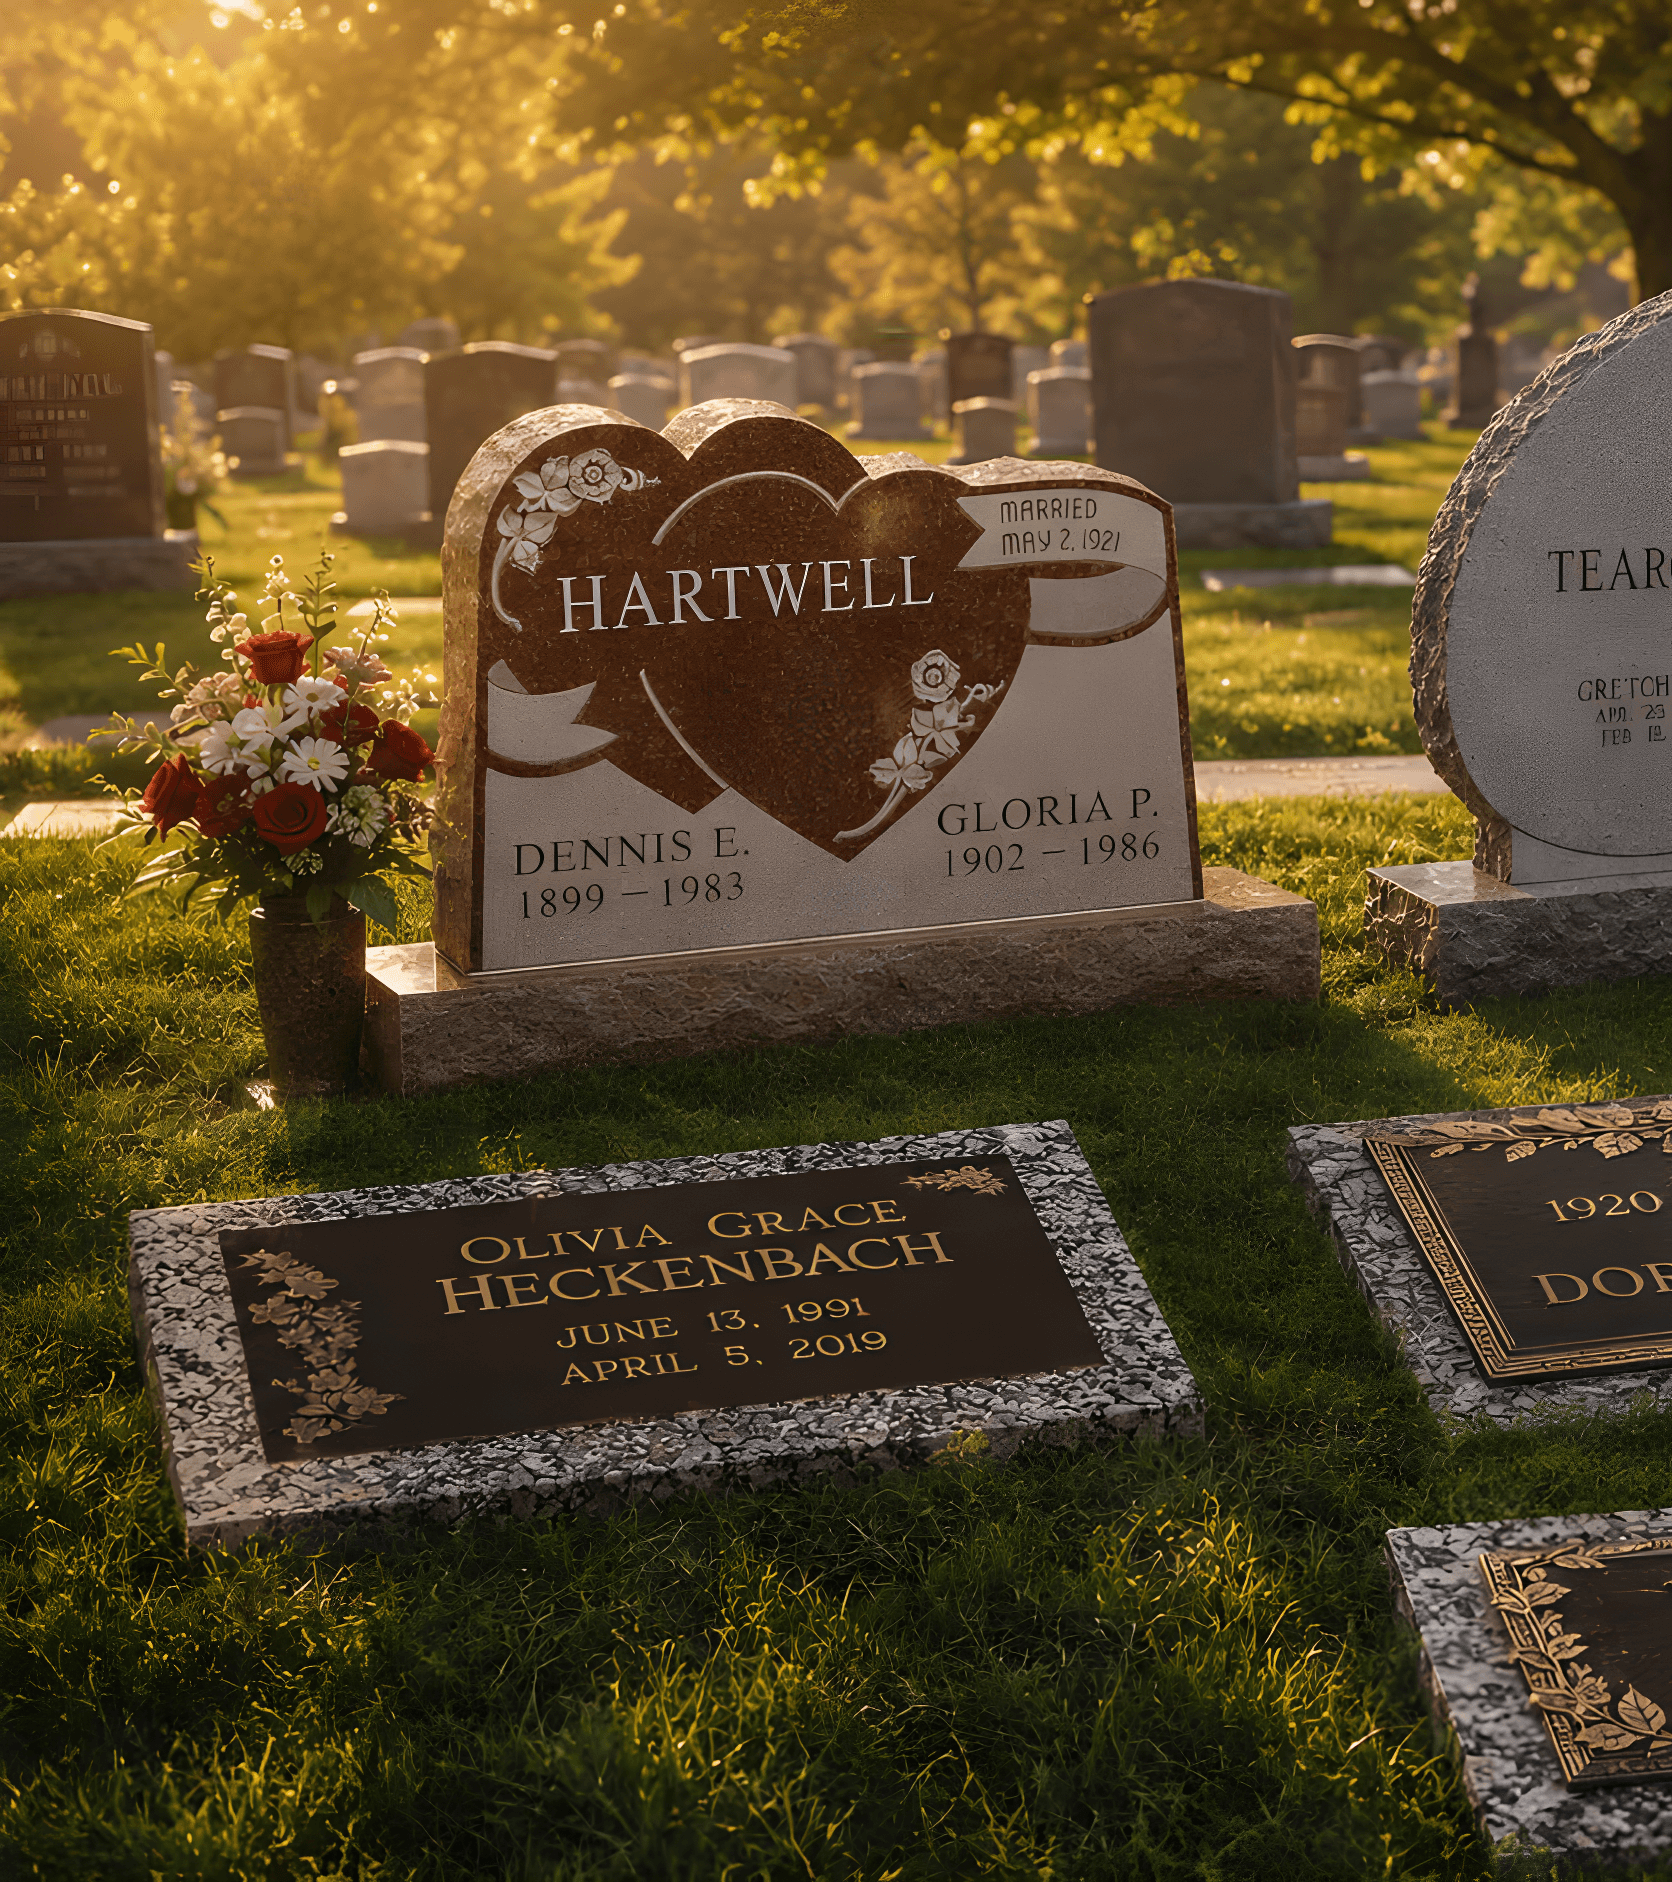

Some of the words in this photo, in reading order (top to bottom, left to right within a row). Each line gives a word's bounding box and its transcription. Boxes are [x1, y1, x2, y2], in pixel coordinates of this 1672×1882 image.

[1000, 498, 1097, 523] MARRIED
[1002, 530, 1051, 555] MAY
[1083, 528, 1120, 552] 1921
[557, 555, 934, 633] HARTWELL
[937, 790, 1113, 836] GLORIA
[1129, 788, 1158, 819] P.
[513, 829, 692, 876] DENNIS
[713, 827, 750, 858] E.
[944, 843, 1025, 877] 1902
[1081, 830, 1160, 866] 1986
[521, 883, 604, 919] 1899
[663, 871, 744, 907] 1983
[1545, 1189, 1664, 1223] 1920
[460, 1223, 673, 1265] OLIVIA
[707, 1199, 907, 1240] GRACE
[436, 1231, 955, 1315] HECKENBACH
[556, 1316, 679, 1350] JUNE
[780, 1296, 871, 1325] 1991
[561, 1351, 698, 1386] APRIL
[788, 1330, 888, 1360] 2019
